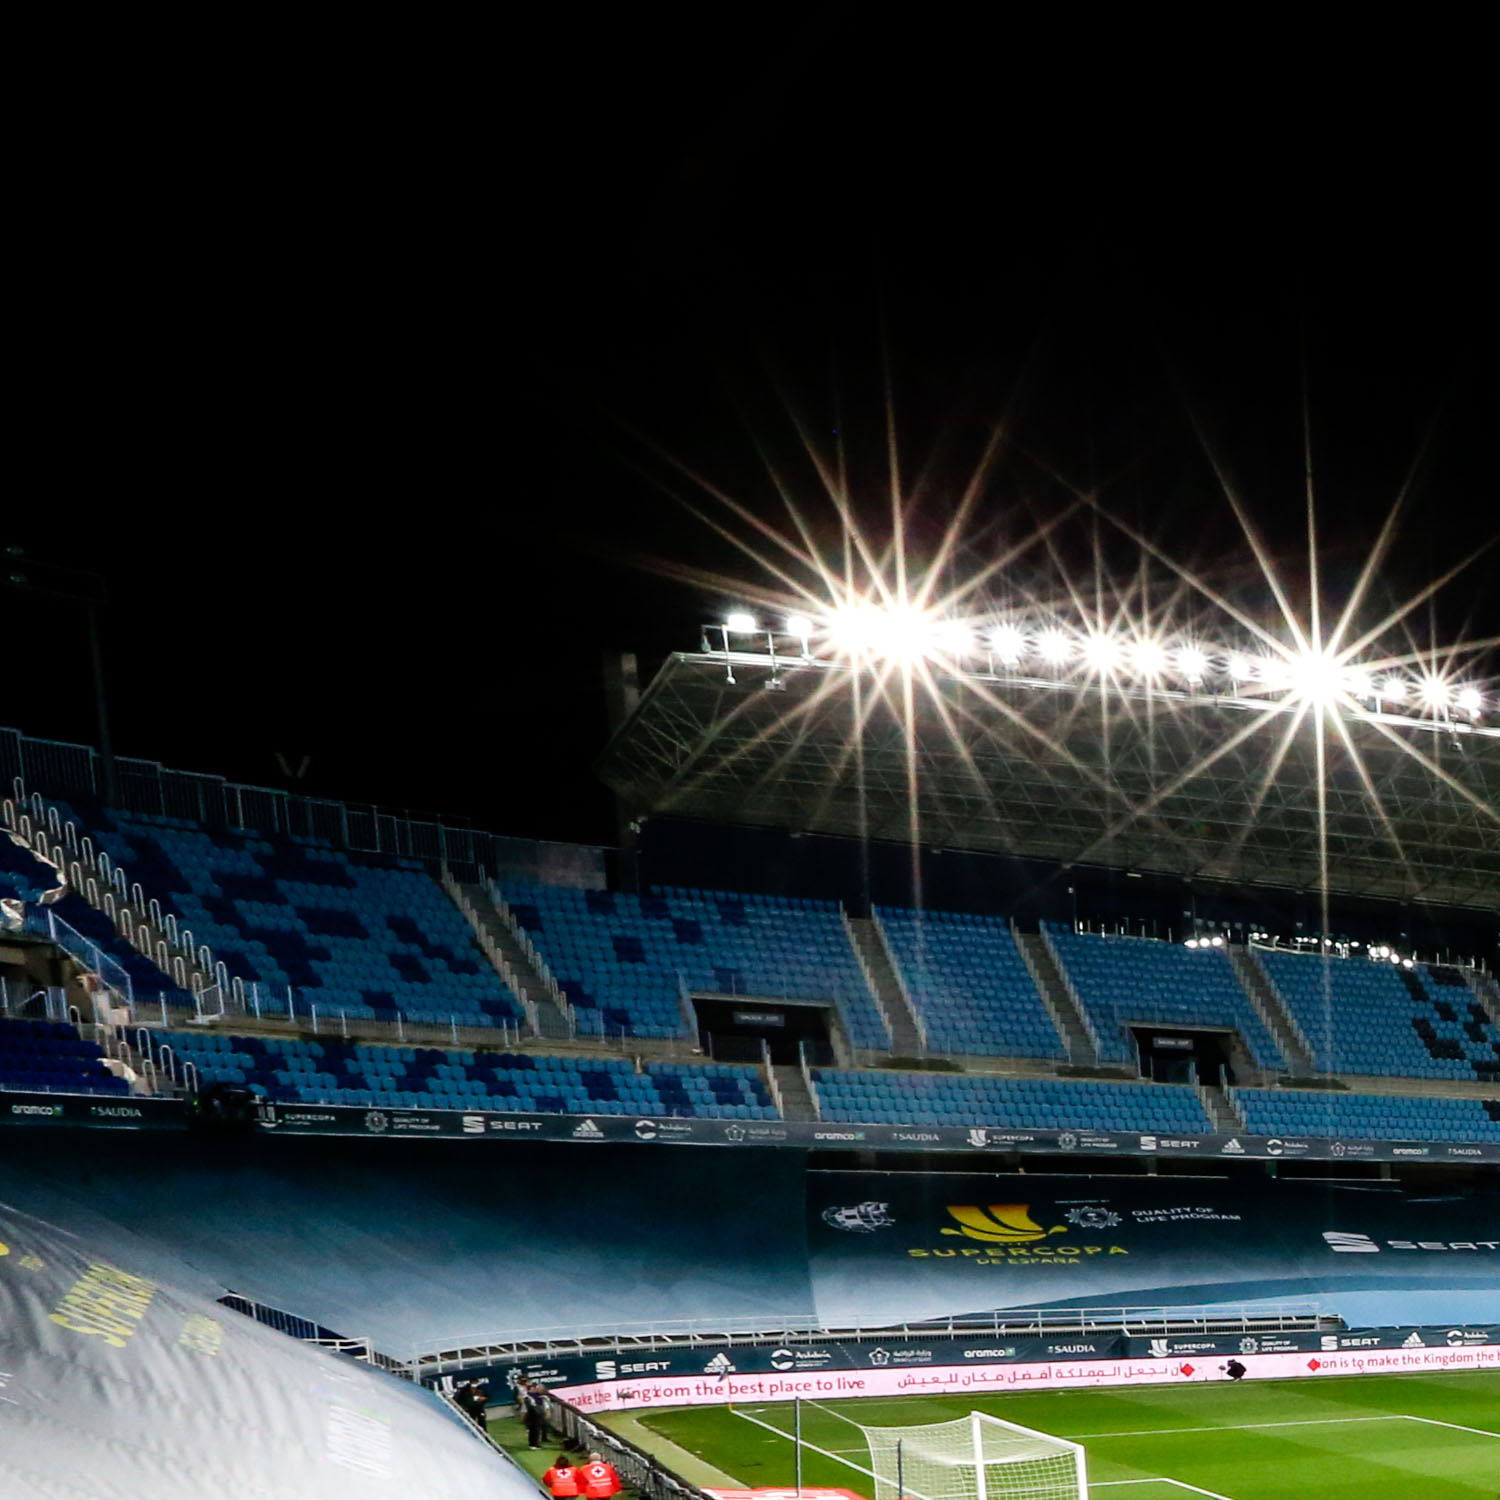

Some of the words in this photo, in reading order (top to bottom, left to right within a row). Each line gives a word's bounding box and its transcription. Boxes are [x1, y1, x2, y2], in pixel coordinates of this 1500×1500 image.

[12, 1105, 53, 1117] aramco
[97, 1106, 142, 1118] SAUDIA
[285, 1113, 336, 1123] SUPERCOPA
[490, 1120, 542, 1131] SEAT
[815, 1132, 855, 1141] aramco
[898, 1132, 940, 1142] SAUDIA
[1159, 1139, 1200, 1149] SEAT
[1452, 1148, 1482, 1156] SAUDIA
[1132, 1208, 1193, 1217] QUALITY
[1168, 1213, 1241, 1223] PROGRAM
[1387, 1239, 1500, 1250] SEAT
[907, 1246, 1129, 1258] SUPERCOPA
[977, 1258, 1006, 1266] DE
[1173, 1342, 1215, 1350] SUPERCOPA
[1341, 1337, 1381, 1346] SEAT
[964, 1348, 1006, 1358] aramco
[1055, 1344, 1096, 1354] SAUDIA
[1340, 1358, 1350, 1368] is
[1351, 1358, 1364, 1367] to
[1367, 1355, 1399, 1367] make
[1402, 1354, 1419, 1365] the
[1424, 1352, 1474, 1366] Kingdom
[1476, 1351, 1495, 1362] the
[620, 1361, 671, 1373] SEAT
[1055, 1366, 1121, 1379] المملكة
[1124, 1366, 1168, 1377] نجعل
[962, 1371, 1004, 1385] مكان
[1008, 1366, 1052, 1383] أفضل
[696, 1383, 724, 1396] the
[728, 1382, 763, 1395] best
[769, 1380, 812, 1396] place
[816, 1378, 833, 1391] to
[837, 1377, 865, 1390] live
[898, 1374, 958, 1388] للعيش
